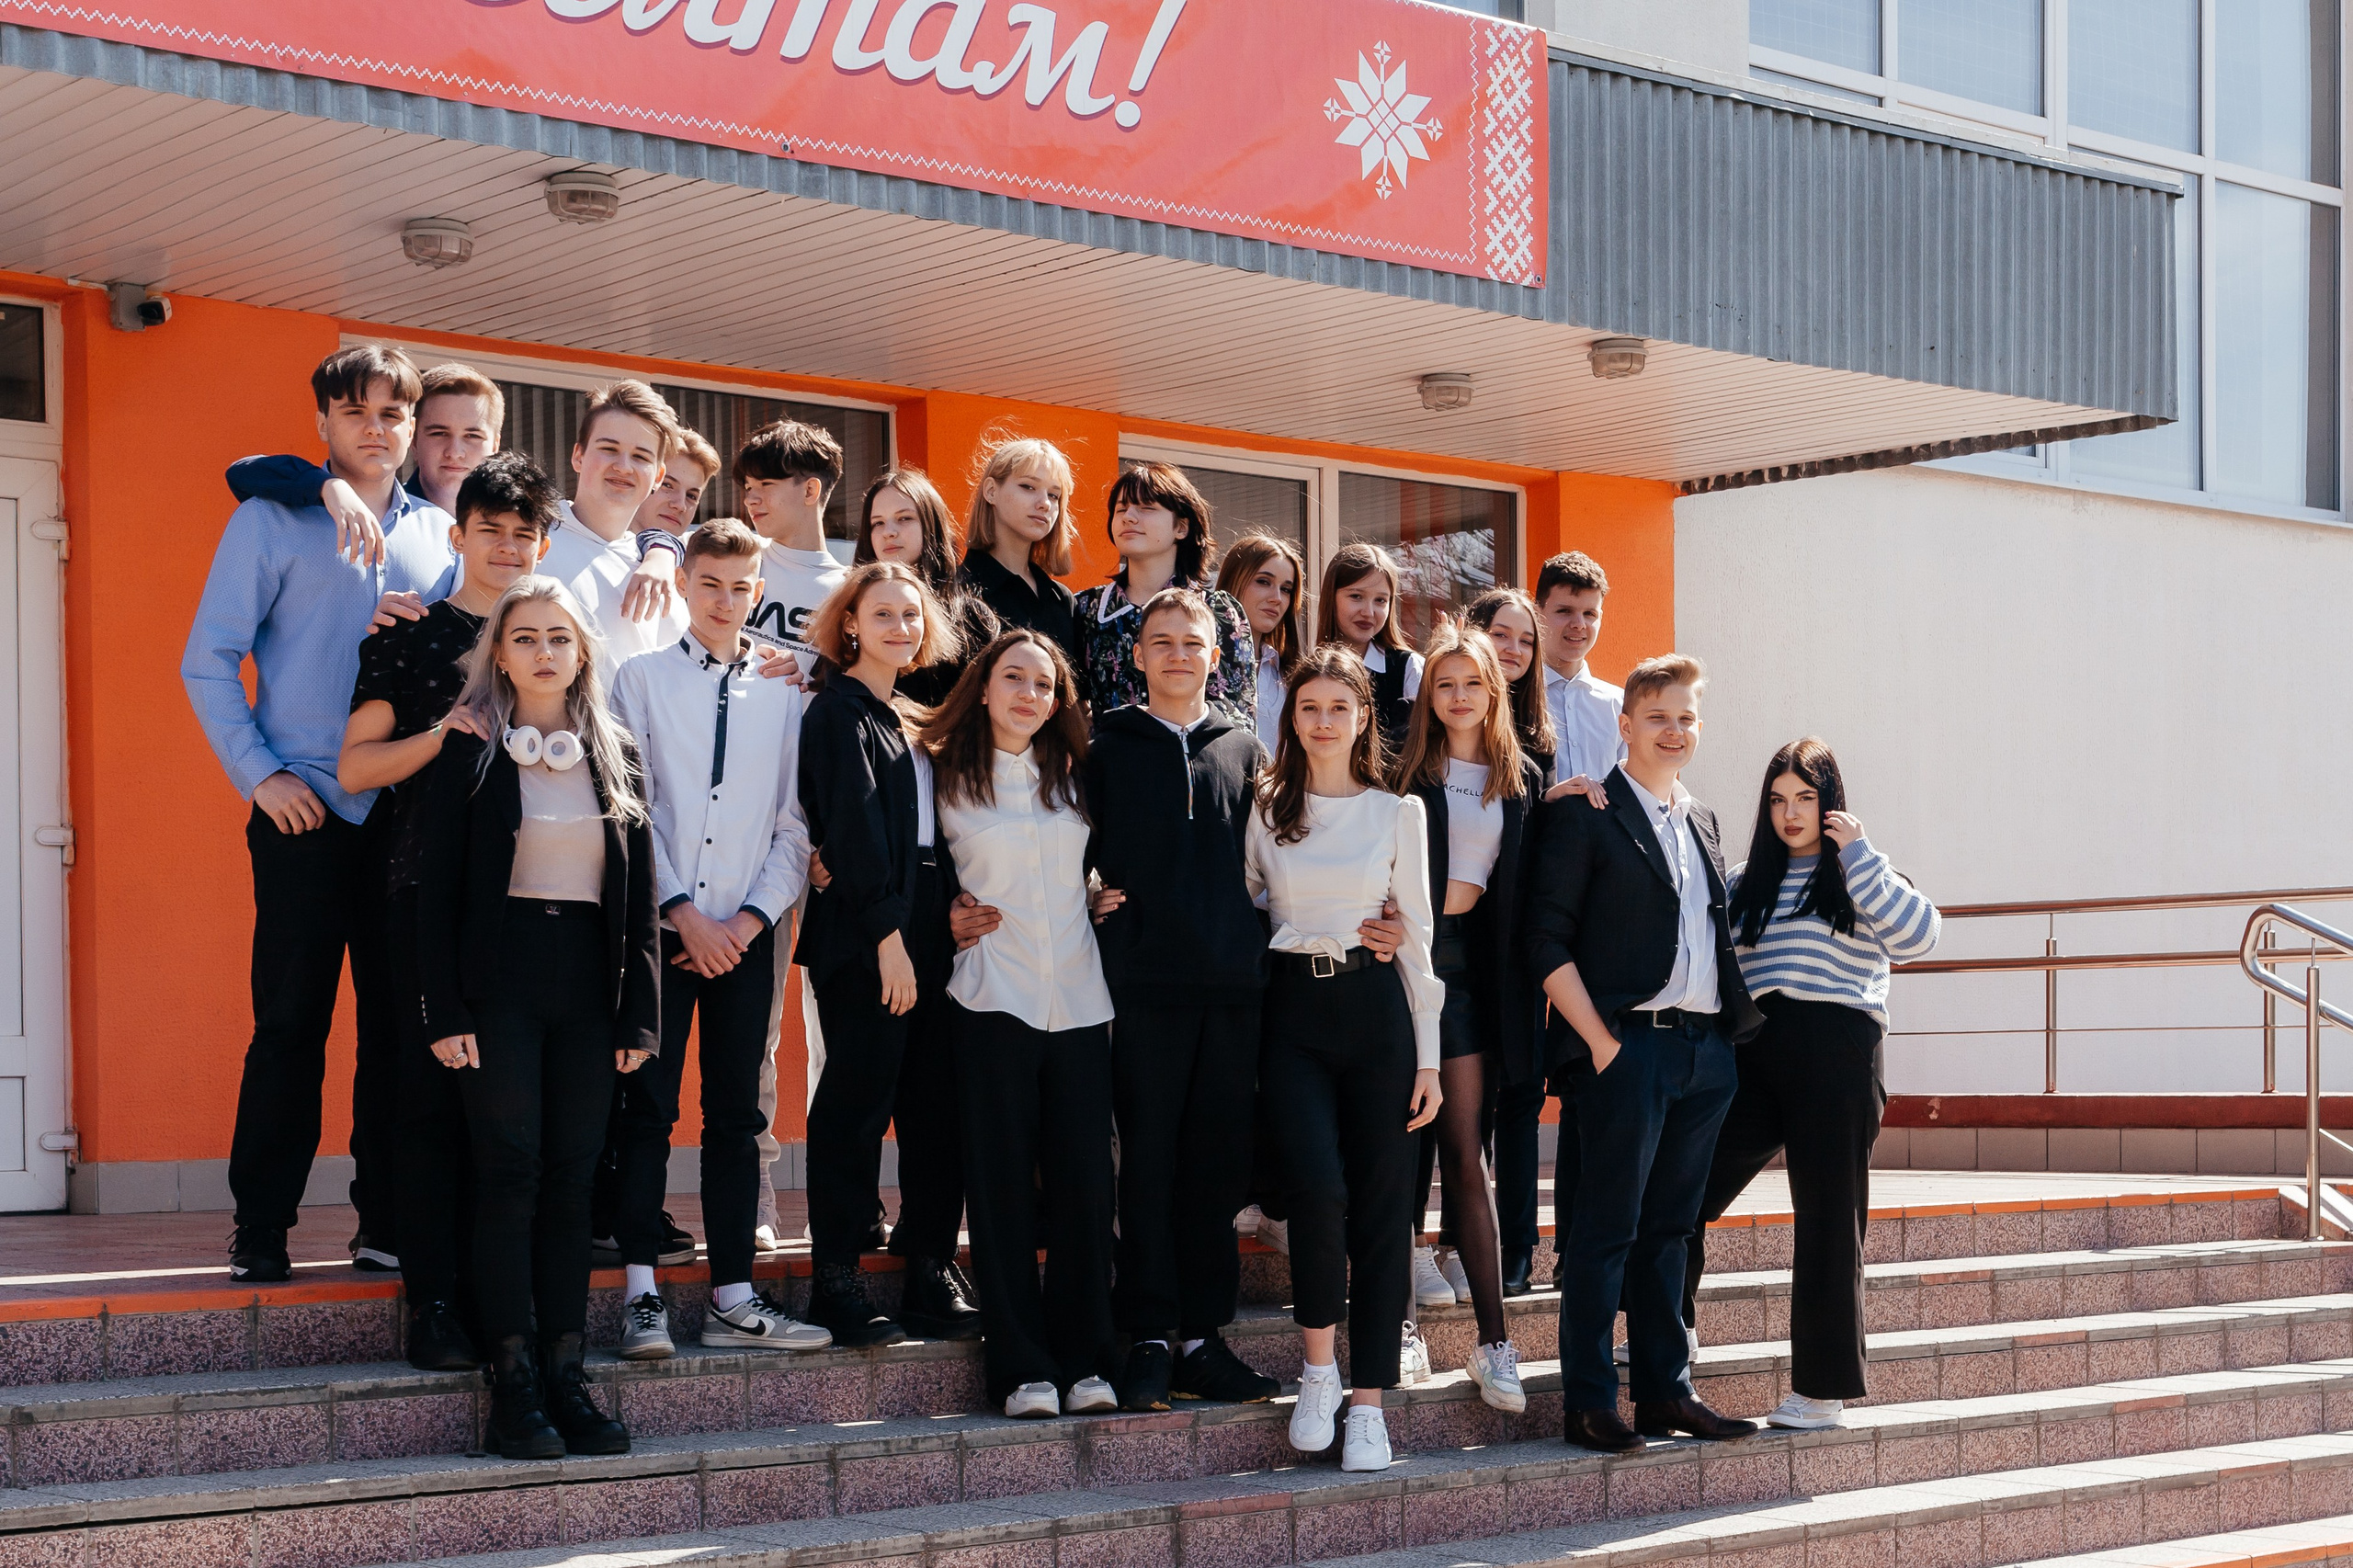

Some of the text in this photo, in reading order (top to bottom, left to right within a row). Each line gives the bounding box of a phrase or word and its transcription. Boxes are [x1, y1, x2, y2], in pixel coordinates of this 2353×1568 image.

[745, 628, 775, 642] Aeronautics
[775, 639, 786, 647] and
[786, 642, 804, 652] Space
